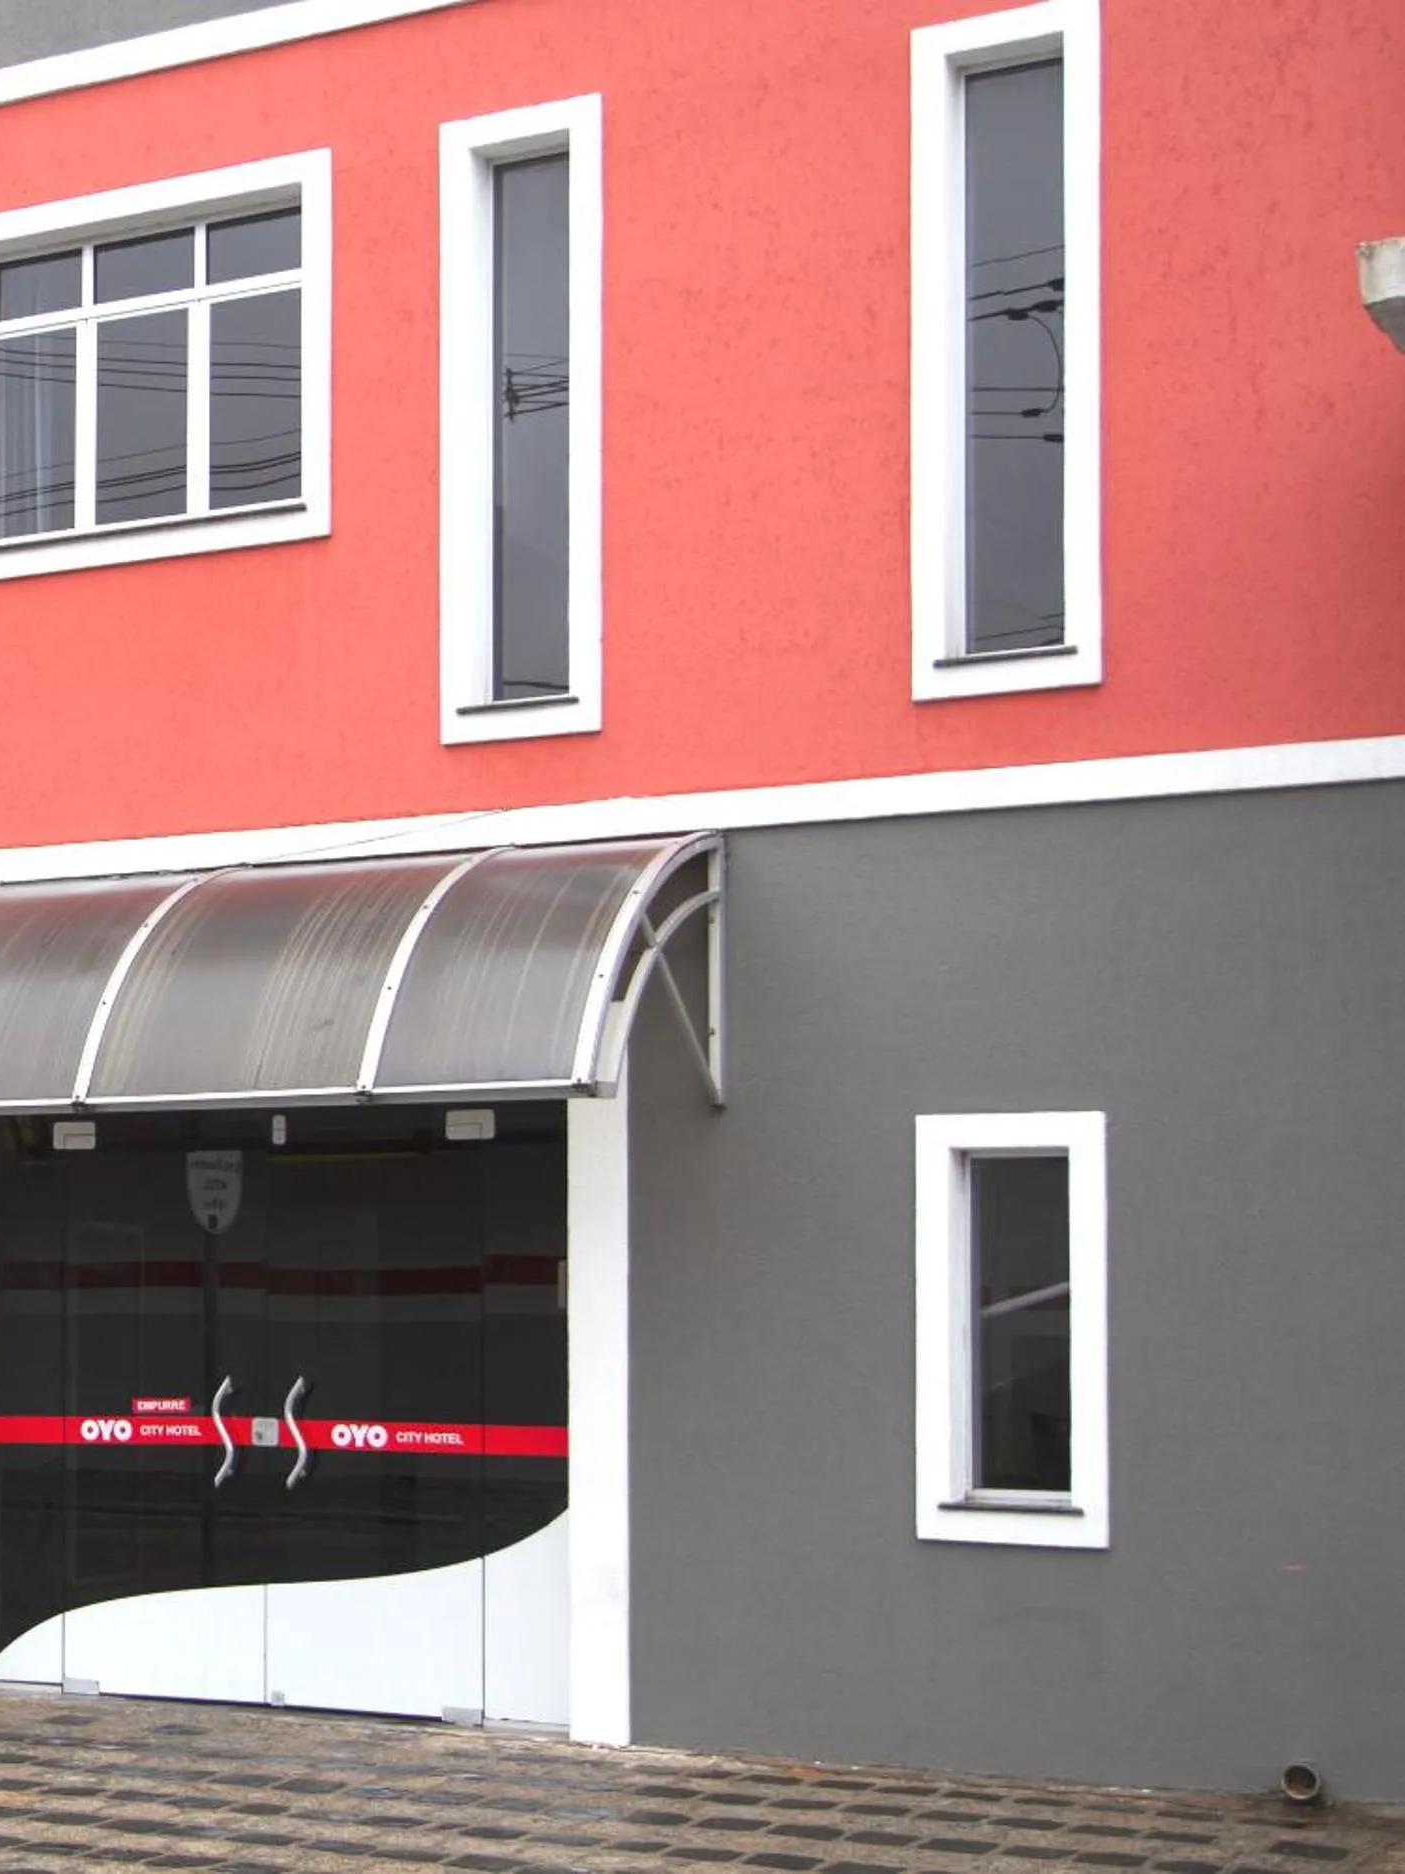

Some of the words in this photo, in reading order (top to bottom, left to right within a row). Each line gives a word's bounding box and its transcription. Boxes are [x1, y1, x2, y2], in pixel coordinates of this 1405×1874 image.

[80, 1419, 133, 1441] OYO
[139, 1425, 165, 1437] CITY
[165, 1425, 203, 1437] HOTEL
[331, 1423, 388, 1448] OYO
[396, 1430, 423, 1443] CITY
[424, 1432, 464, 1446] HOTEL
